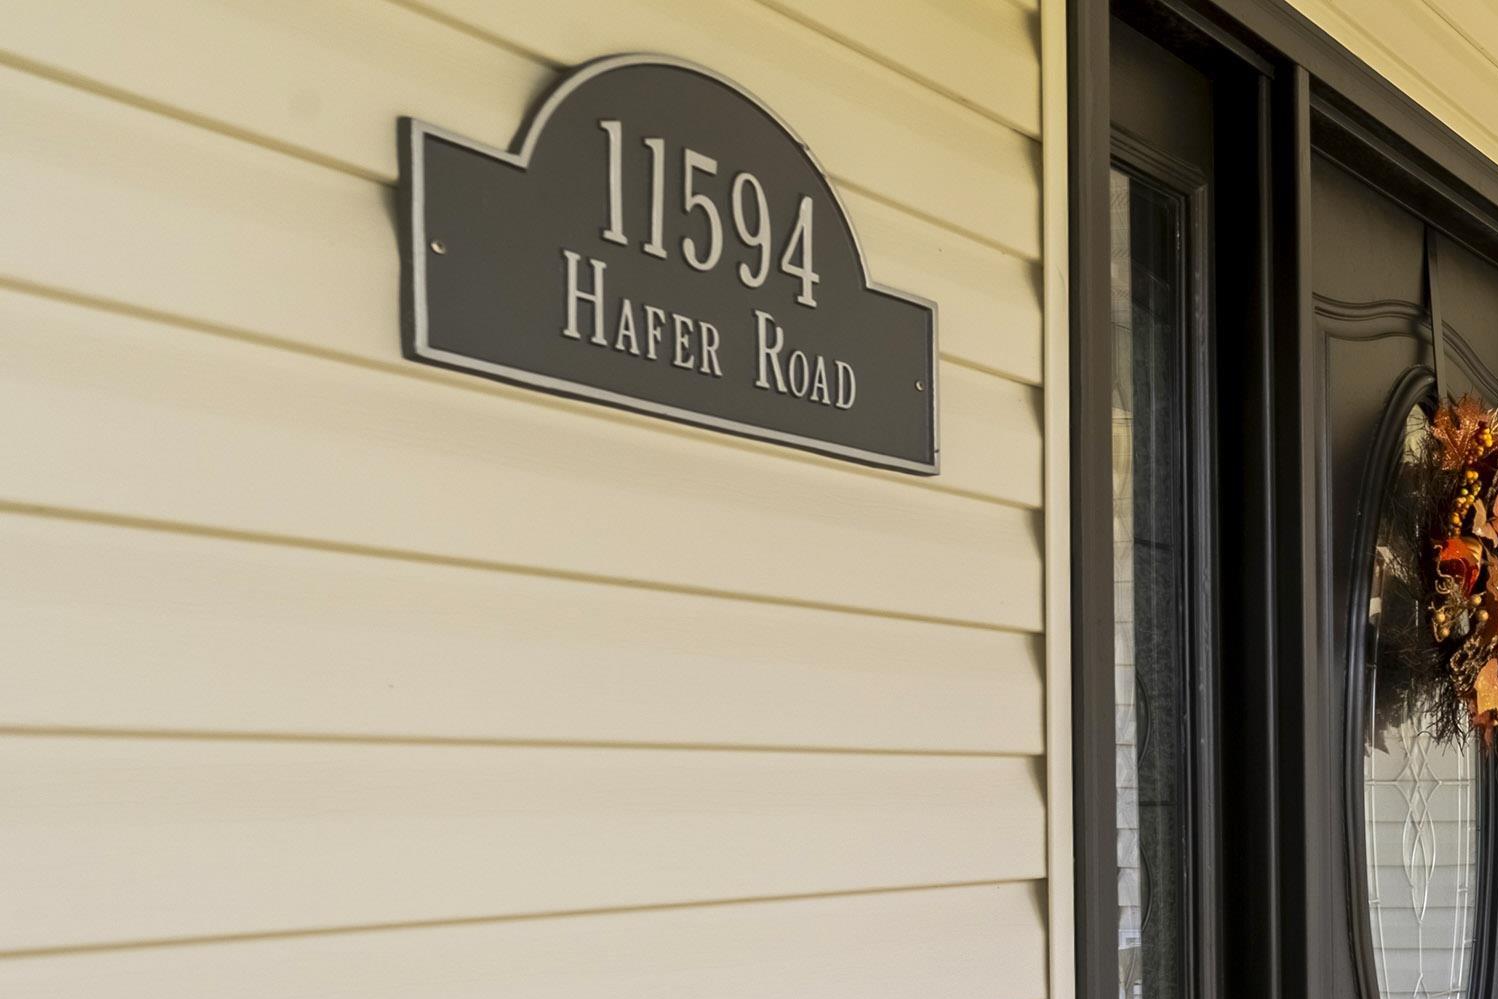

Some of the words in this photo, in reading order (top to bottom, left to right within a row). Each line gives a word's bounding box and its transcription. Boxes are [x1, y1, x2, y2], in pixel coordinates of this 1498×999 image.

[599, 120, 820, 308] 11594
[562, 250, 723, 377] HAFER
[753, 310, 857, 409] ROAD
